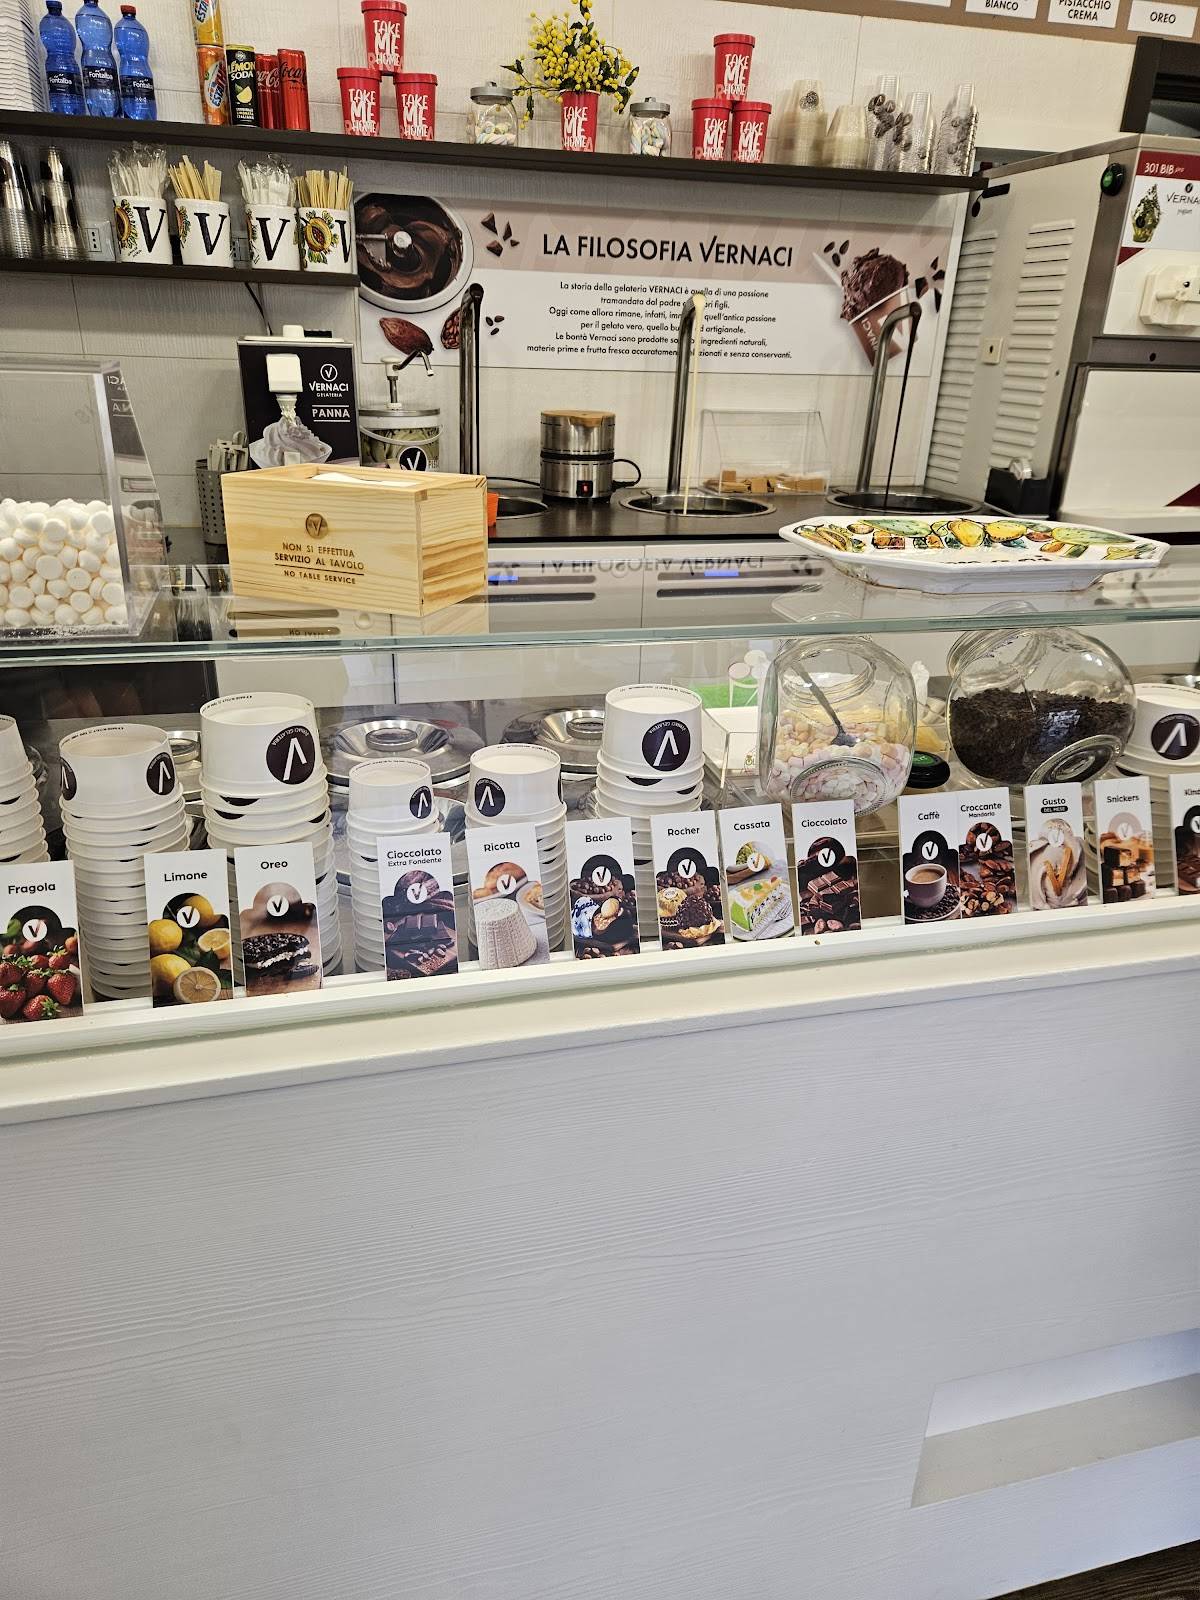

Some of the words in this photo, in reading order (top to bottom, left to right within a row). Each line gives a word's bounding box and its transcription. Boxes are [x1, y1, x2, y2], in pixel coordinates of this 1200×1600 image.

[985, 0, 1018, 10] BIANCO
[1068, 9, 1098, 21] CREMA
[1150, 12, 1176, 24] OREO
[373, 20, 400, 38] TAKE
[375, 33, 400, 56] ME
[376, 52, 400, 66] HOME
[724, 54, 749, 67] TAKE
[88, 71, 114, 80] Fontalba
[231, 70, 254, 80] SODA
[724, 65, 748, 85] ME
[724, 84, 747, 95] HOME
[349, 89, 376, 106] TAKE
[401, 94, 428, 110] TAKE
[351, 100, 376, 122] ME
[403, 105, 428, 127] ME
[563, 106, 588, 121] TAKE
[352, 120, 376, 133] HOME
[404, 124, 428, 137] HOME
[564, 117, 588, 138] ME
[704, 118, 727, 132] TAKE
[740, 121, 764, 135] TAKE
[564, 136, 587, 148] HOME
[703, 129, 726, 149] ME
[739, 132, 763, 152] ME
[703, 147, 724, 158] HOME
[739, 150, 760, 160] HOME
[1144, 162, 1159, 173] 301
[133, 206, 166, 253] V
[194, 212, 227, 255] V
[256, 217, 290, 261] V
[543, 234, 571, 256] LA
[577, 235, 693, 263] FILOSOFIA
[699, 235, 793, 267] VERNACI
[560, 281, 569, 289] La
[571, 283, 592, 291] storia
[594, 283, 613, 291] della
[614, 283, 647, 293] gelateria
[648, 286, 683, 295] VERNACI
[684, 286, 689, 294] è
[714, 287, 722, 296] di
[723, 289, 737, 297] una
[738, 289, 769, 299] passione
[600, 297, 644, 306] tramandata
[646, 298, 658, 306] dal
[659, 299, 681, 308] padre
[714, 300, 730, 310] figli.
[549, 306, 569, 317] Oggi
[569, 309, 590, 317] come
[591, 308, 614, 317] allora
[615, 309, 643, 319] rimane,
[644, 311, 668, 320] infatti,
[704, 312, 745, 323] quell'antica
[745, 315, 777, 324] passione
[580, 321, 593, 330] per
[594, 320, 600, 328] il
[601, 321, 625, 331] gelato
[626, 324, 645, 332] vero,
[646, 323, 669, 332] quella
[705, 326, 747, 334] artigianale.
[555, 332, 564, 340] Le
[565, 332, 588, 341] bontà
[589, 333, 617, 342] Vernaci
[637, 336, 669, 345] prodotte
[700, 337, 738, 347] ingredienti
[739, 338, 768, 347] naturali,
[527, 345, 556, 353] materie
[557, 345, 579, 354] prime
[586, 345, 607, 354] frutta
[608, 346, 630, 355] fresca
[631, 347, 679, 356] accuratamen
[750, 351, 792, 359] conservanti.
[308, 380, 349, 392] VERNACI
[311, 408, 351, 418] PANNA
[406, 451, 421, 470] V
[282, 542, 301, 552] NON
[306, 545, 314, 553] SI
[318, 546, 355, 558] EFFETTUA
[274, 552, 311, 564] SERVIZIO
[315, 557, 326, 566] AL
[329, 558, 364, 570] TAVOLO
[299, 571, 321, 580] TABLE
[324, 574, 356, 584] SERVICE
[1042, 798, 1066, 806] Gusto
[1106, 795, 1140, 803] Snickers
[960, 803, 1002, 813] Croccante
[801, 816, 848, 828] Cioccolato
[917, 810, 941, 821] Caffè
[667, 826, 700, 837] Rocher
[733, 820, 771, 831] Cassata
[585, 832, 613, 843] Bacio
[483, 840, 521, 852] Ricotta
[386, 848, 442, 859] Cioccolato
[260, 860, 289, 870] Oreo
[408, 857, 442, 866] Fondente
[163, 871, 208, 882] Limone
[8, 882, 56, 895] Fragola
